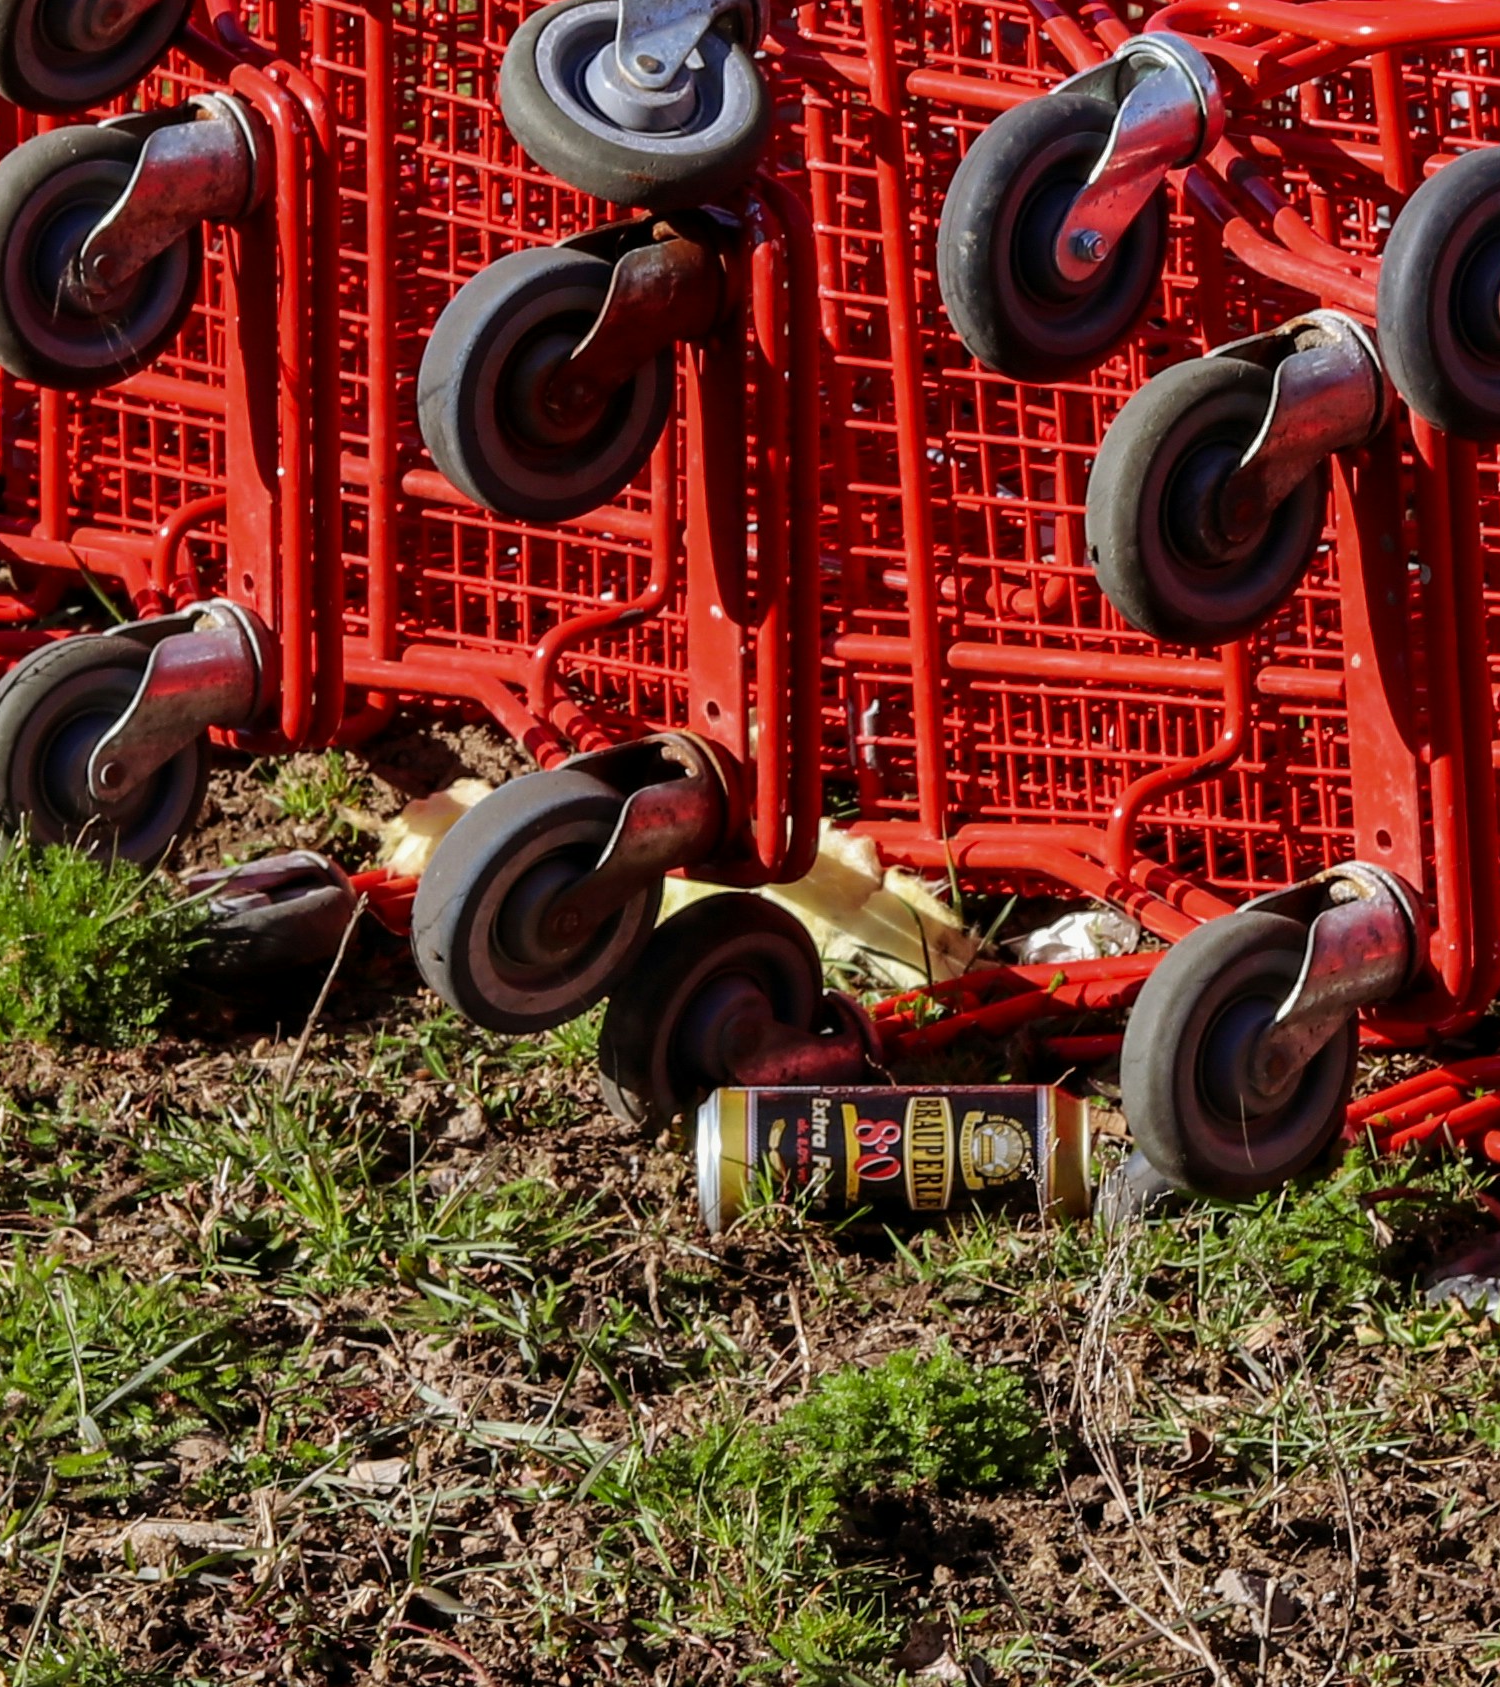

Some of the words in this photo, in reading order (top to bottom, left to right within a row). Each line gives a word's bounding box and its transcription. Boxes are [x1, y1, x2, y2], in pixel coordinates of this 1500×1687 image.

[812, 1098, 831, 1148] Extra
[962, 1120, 974, 1178] TRADITION
[912, 1100, 944, 1207] BRAUPERLE
